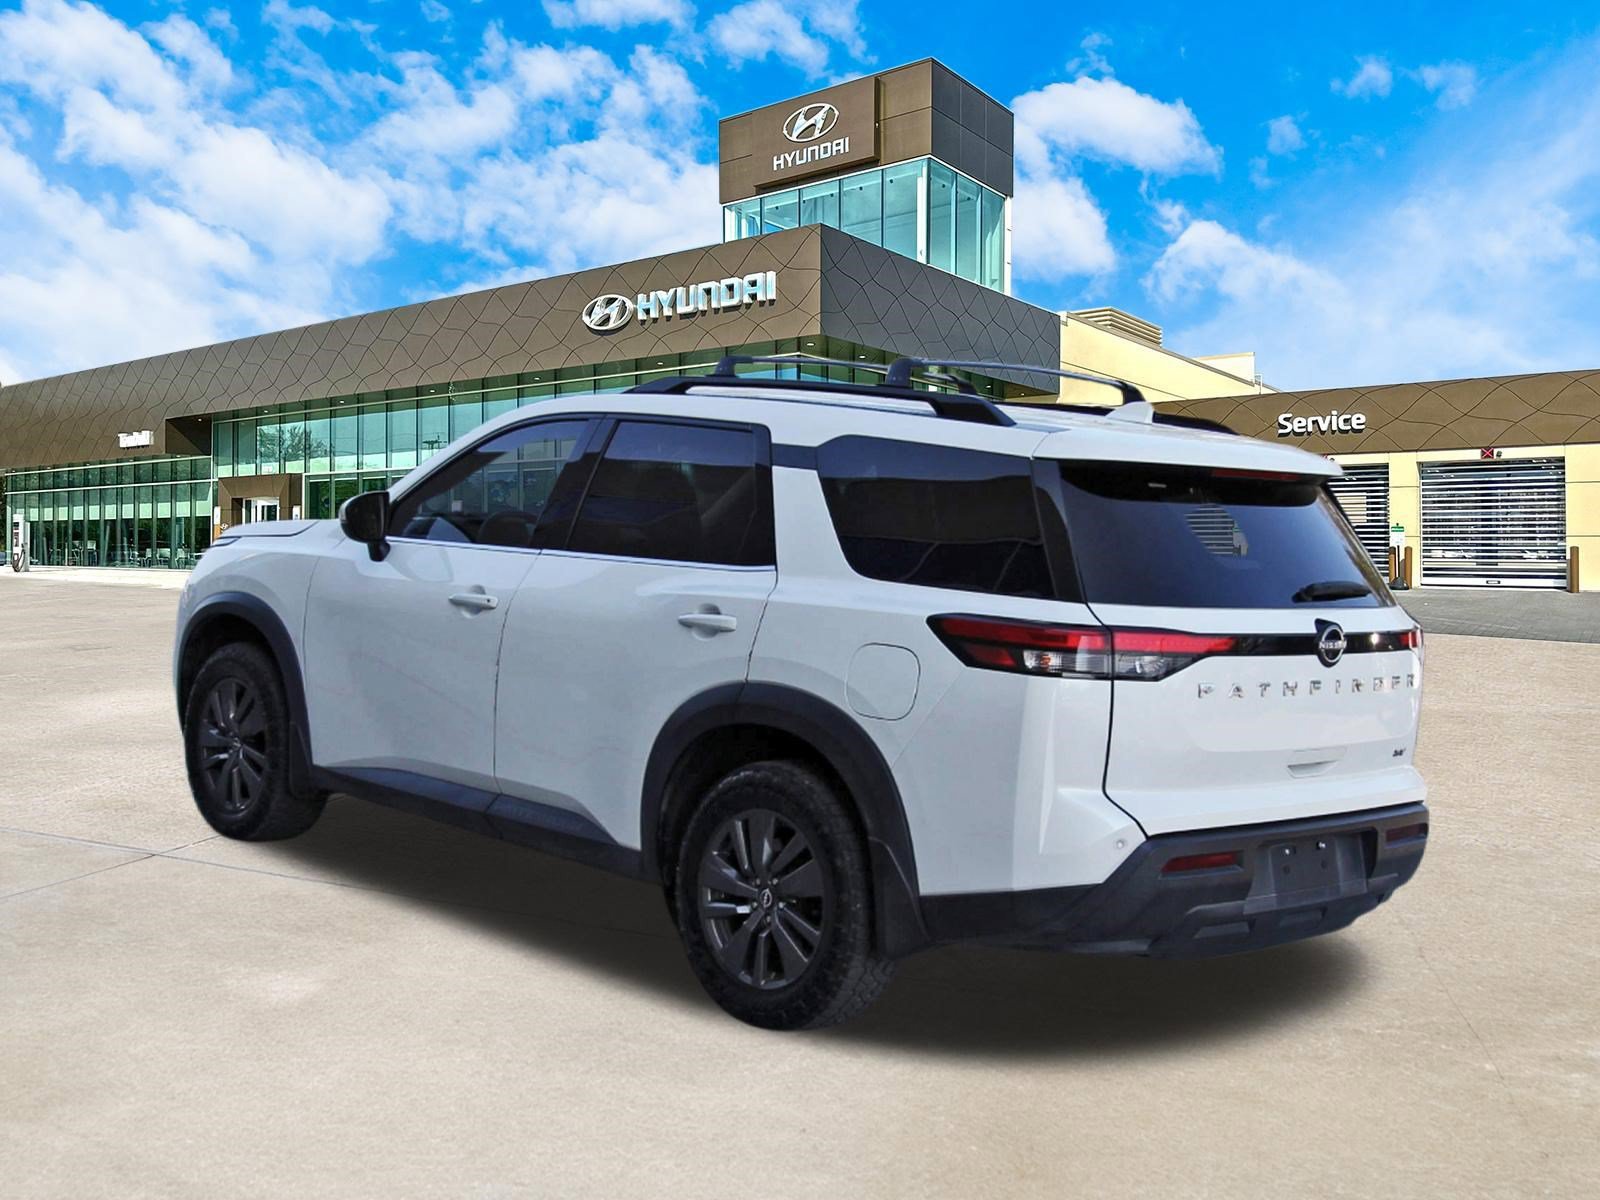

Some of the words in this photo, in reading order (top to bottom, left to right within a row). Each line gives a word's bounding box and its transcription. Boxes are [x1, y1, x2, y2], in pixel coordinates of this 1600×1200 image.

[773, 137, 849, 171] HYUNDAI
[636, 270, 777, 321] HYUNDAI
[1277, 410, 1366, 435] Service
